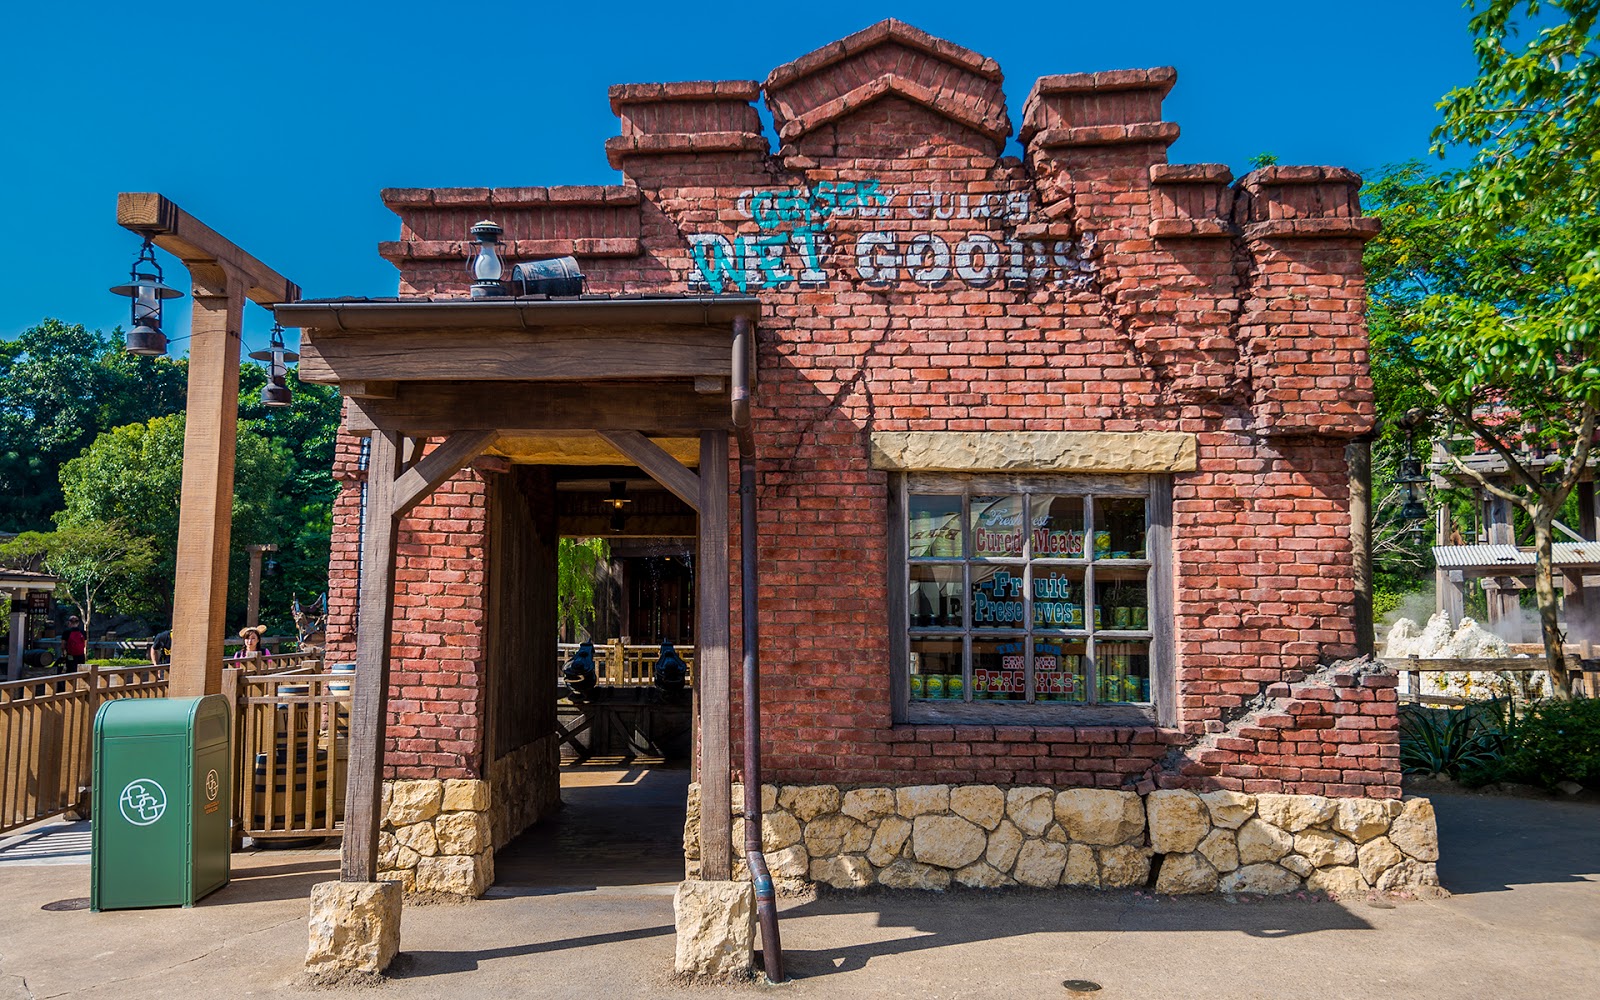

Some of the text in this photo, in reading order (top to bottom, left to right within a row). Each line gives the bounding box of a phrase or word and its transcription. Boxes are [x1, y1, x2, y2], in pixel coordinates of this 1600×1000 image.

[975, 527, 1024, 553] Cured
[1033, 528, 1083, 554] Meats
[993, 571, 1069, 599] Fruit
[975, 593, 1074, 623] Preserves
[995, 642, 1062, 656] TRY OUR
[975, 668, 1074, 693] PEACHES
